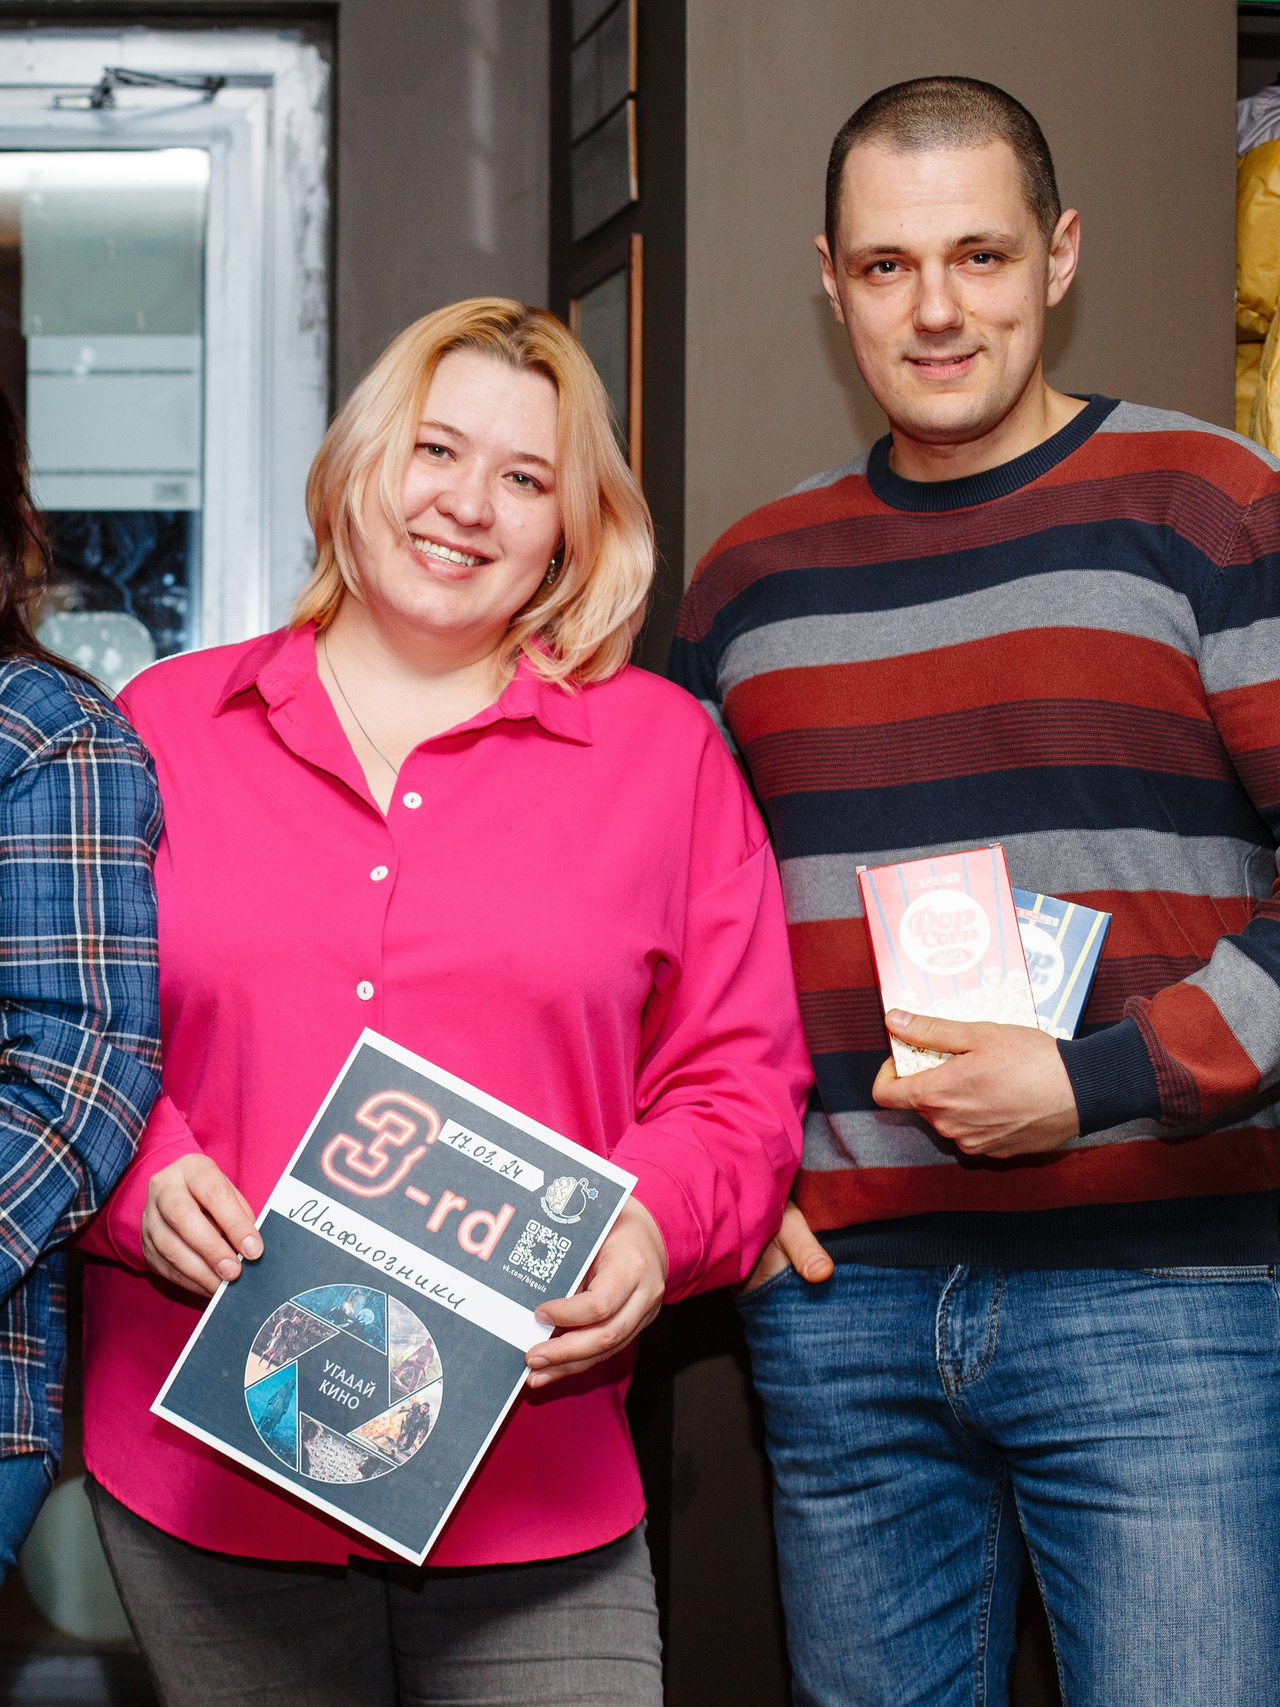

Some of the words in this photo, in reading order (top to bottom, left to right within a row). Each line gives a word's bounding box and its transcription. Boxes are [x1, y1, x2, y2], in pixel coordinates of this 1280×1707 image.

[1017, 909, 1048, 923] SPAR
[288, 1199, 466, 1310] Мафиозники
[502, 1264, 548, 1293] vk.com/bigquiz
[318, 1379, 360, 1410] КИНО
[322, 1359, 377, 1399] УГАДАЙ
